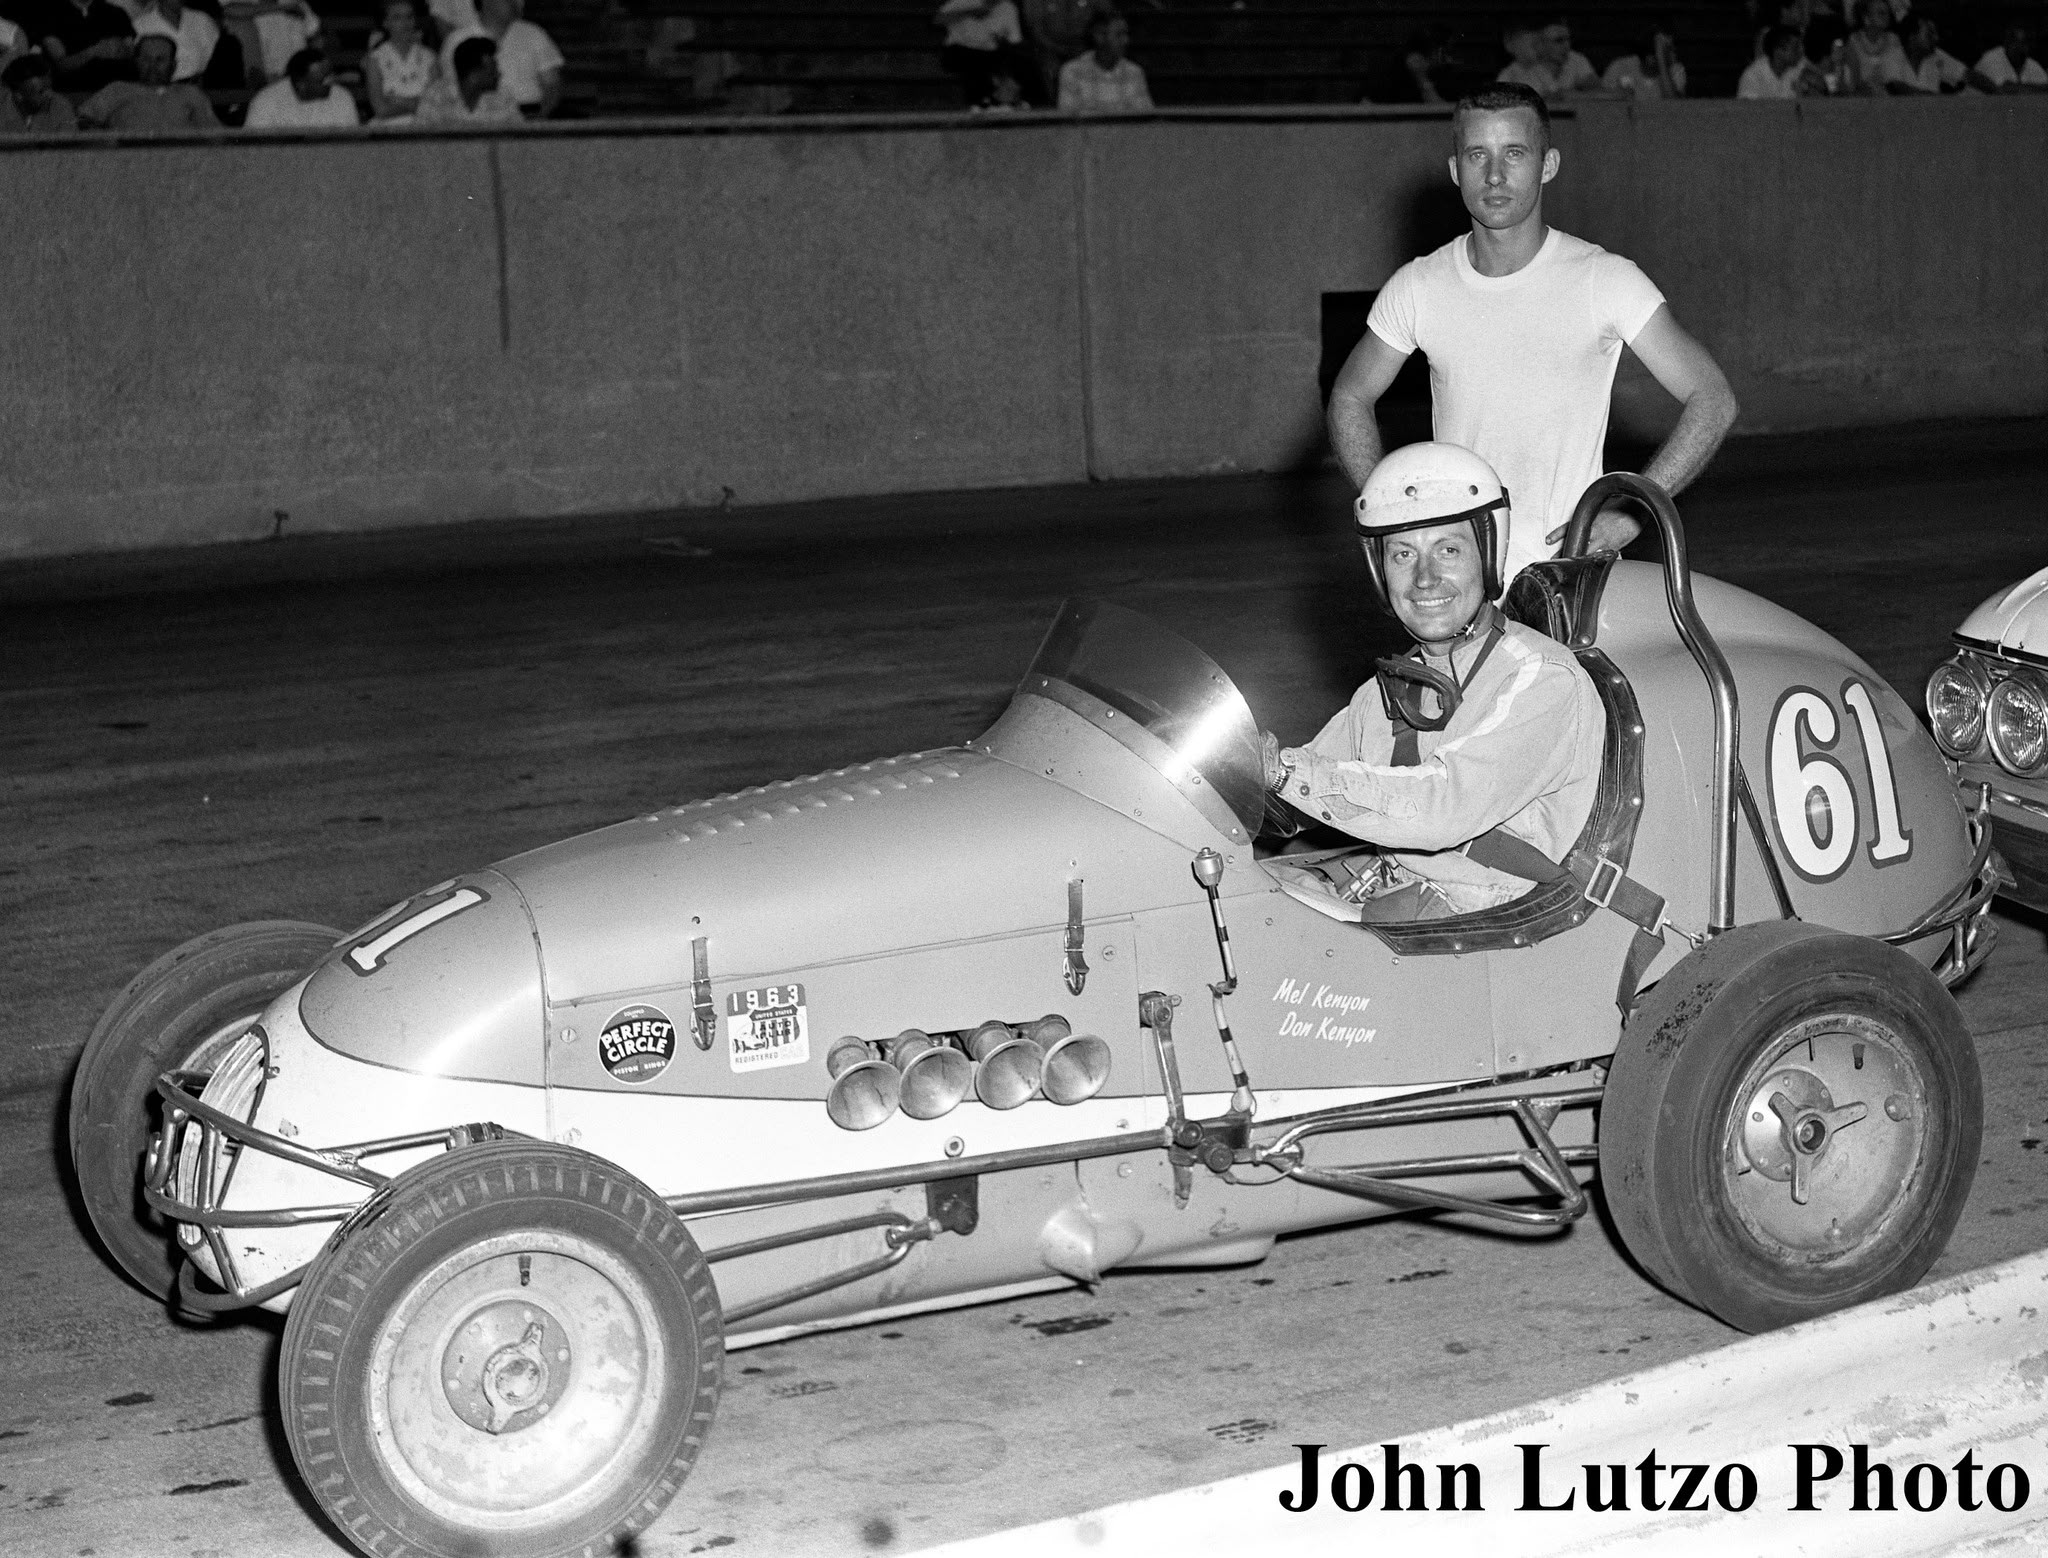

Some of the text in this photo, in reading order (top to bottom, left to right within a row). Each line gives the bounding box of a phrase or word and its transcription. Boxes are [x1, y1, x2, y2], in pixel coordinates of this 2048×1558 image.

[1766, 678, 1912, 883] 61
[733, 985, 798, 1011] 1963
[1273, 978, 1370, 1016] Mel Kenyon
[600, 1021, 671, 1049] PERFECT
[760, 1020, 792, 1031] AUTO
[1279, 1011, 1377, 1048] Don Kenyon
[607, 1037, 668, 1062] CIRCLE
[735, 1052, 779, 1064] REGISTERED
[614, 1061, 666, 1075] PISTON RINGS
